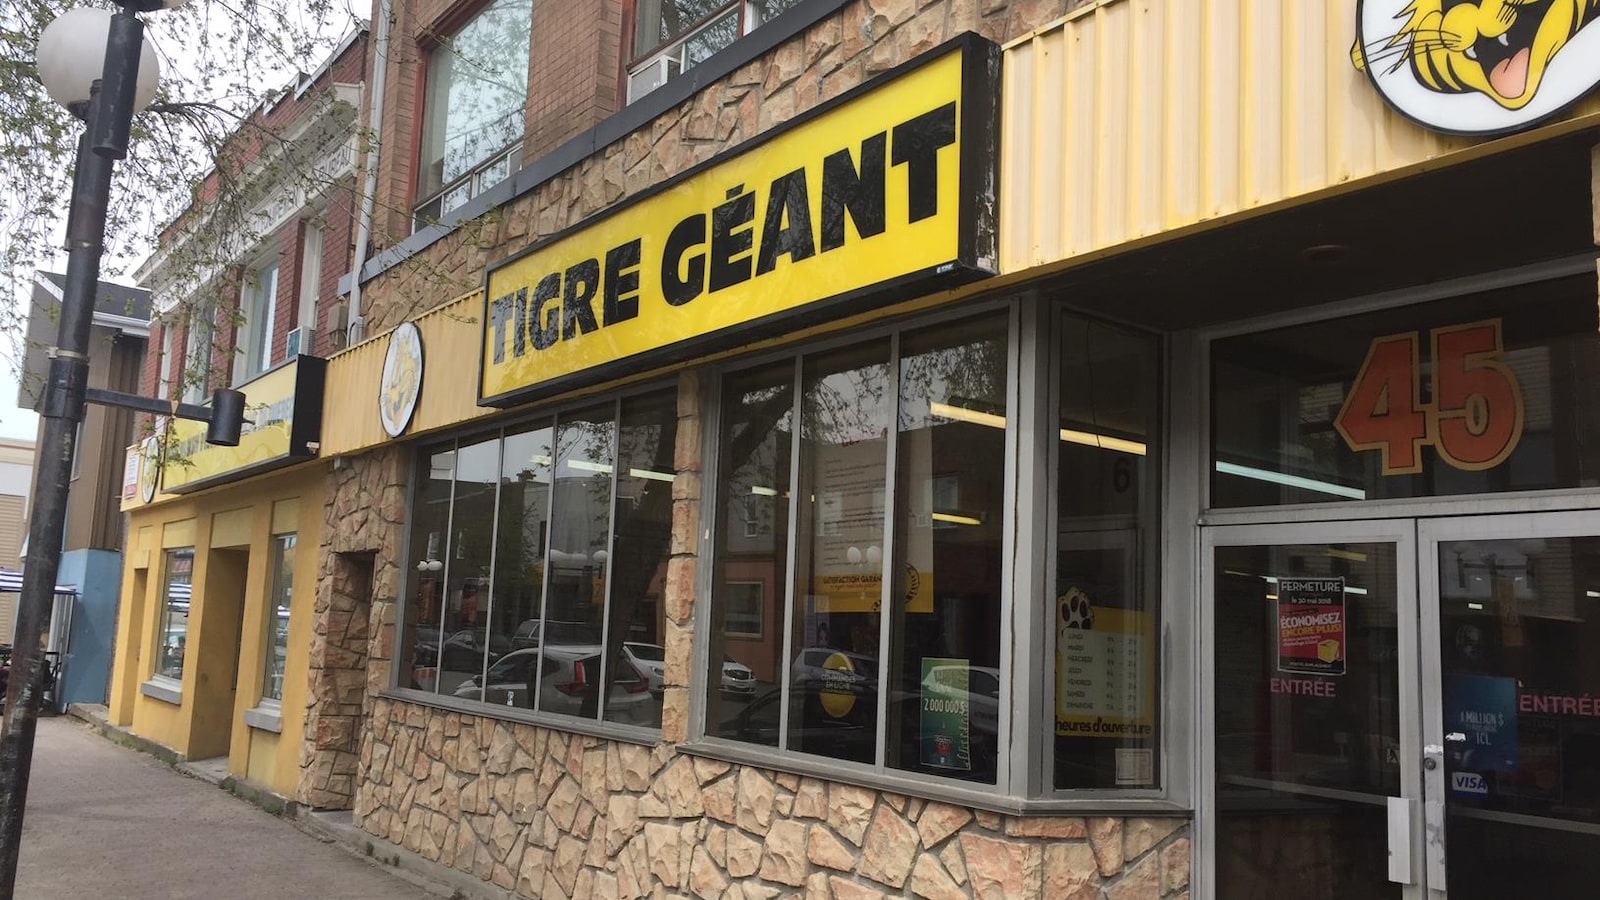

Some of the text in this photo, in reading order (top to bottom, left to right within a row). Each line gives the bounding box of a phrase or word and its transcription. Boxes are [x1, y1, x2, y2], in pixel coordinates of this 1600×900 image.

[490, 101, 956, 365] TIGRE GÉANT
[1333, 317, 1524, 476] 45
[1281, 581, 1341, 592] FERMETURE
[1280, 612, 1342, 630] ÉCONOMISEZ
[1282, 625, 1317, 638] ENCORE
[1270, 676, 1336, 697] ENTRÉE
[1093, 716, 1152, 735] d'ouverture
[1465, 711, 1497, 725] MILLION
[1456, 776, 1487, 790] VISA
